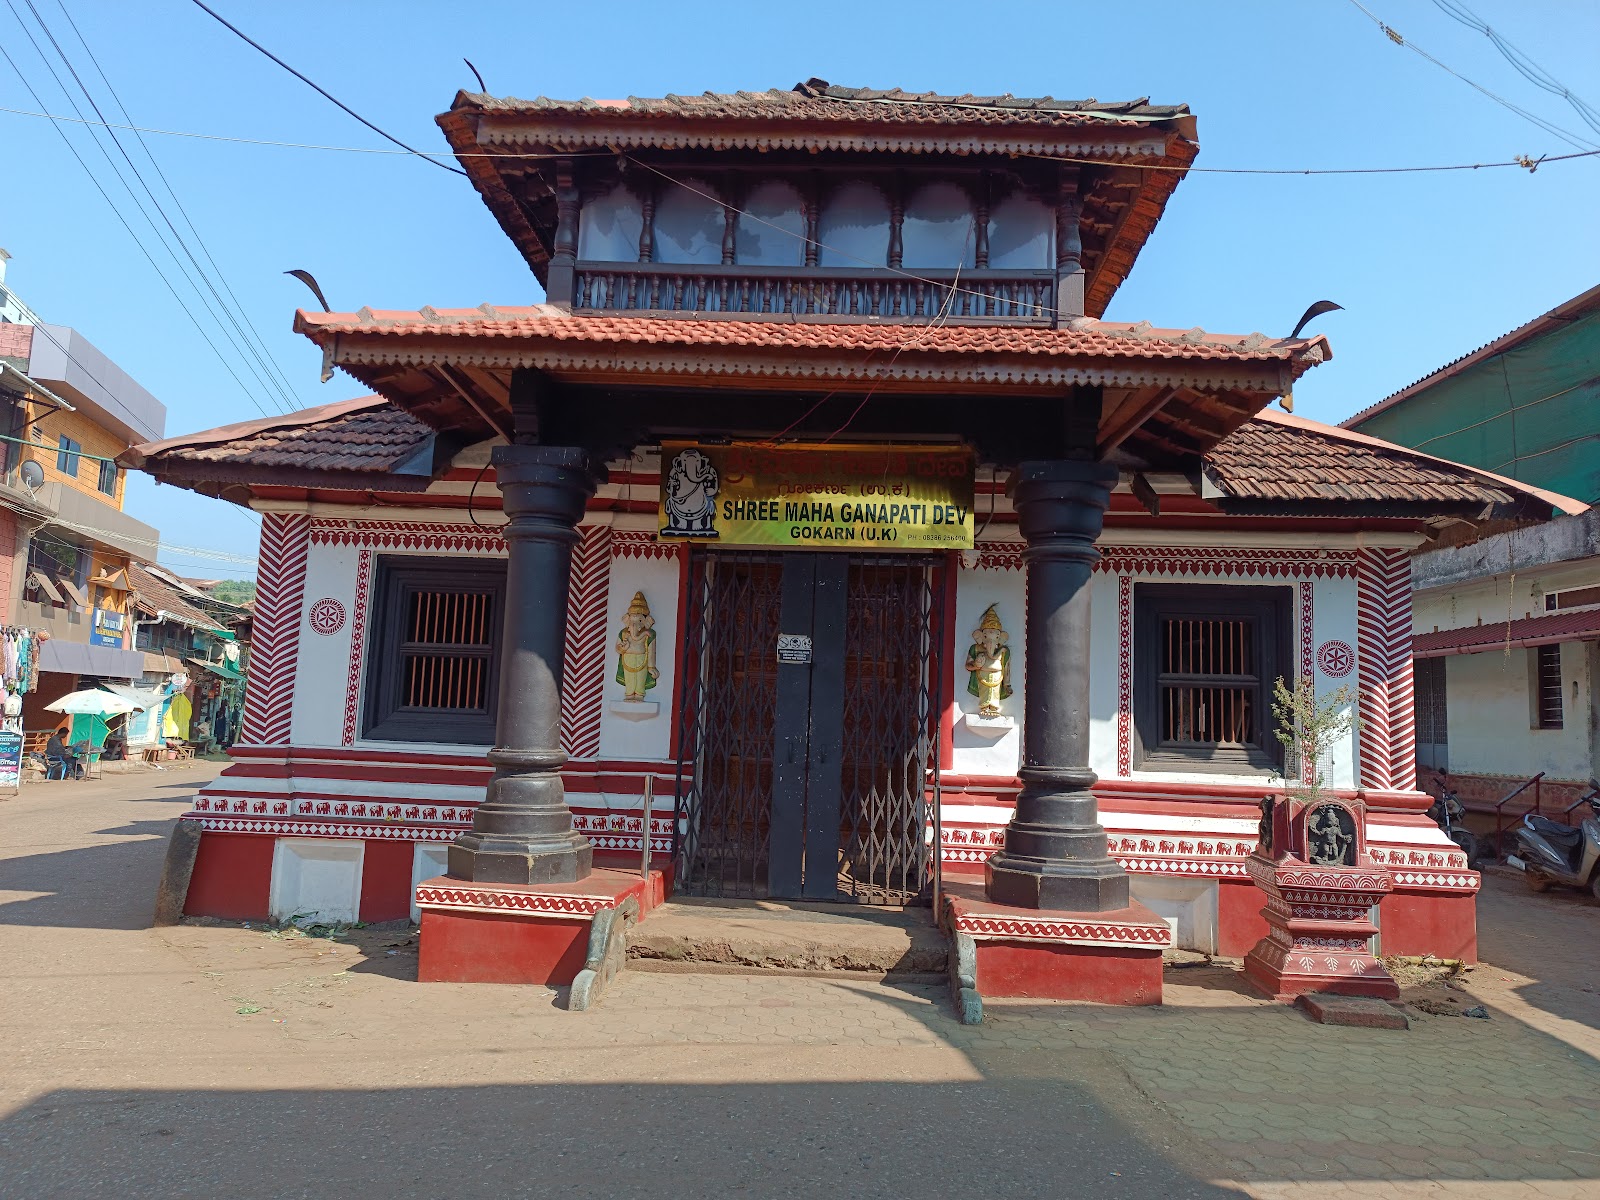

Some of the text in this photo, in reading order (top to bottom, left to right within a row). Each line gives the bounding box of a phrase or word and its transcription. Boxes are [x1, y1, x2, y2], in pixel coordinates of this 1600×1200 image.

[723, 500, 967, 526] SHREE MAHA GANAPATI DEV
[790, 525, 898, 541] GOKARN (U.K)
